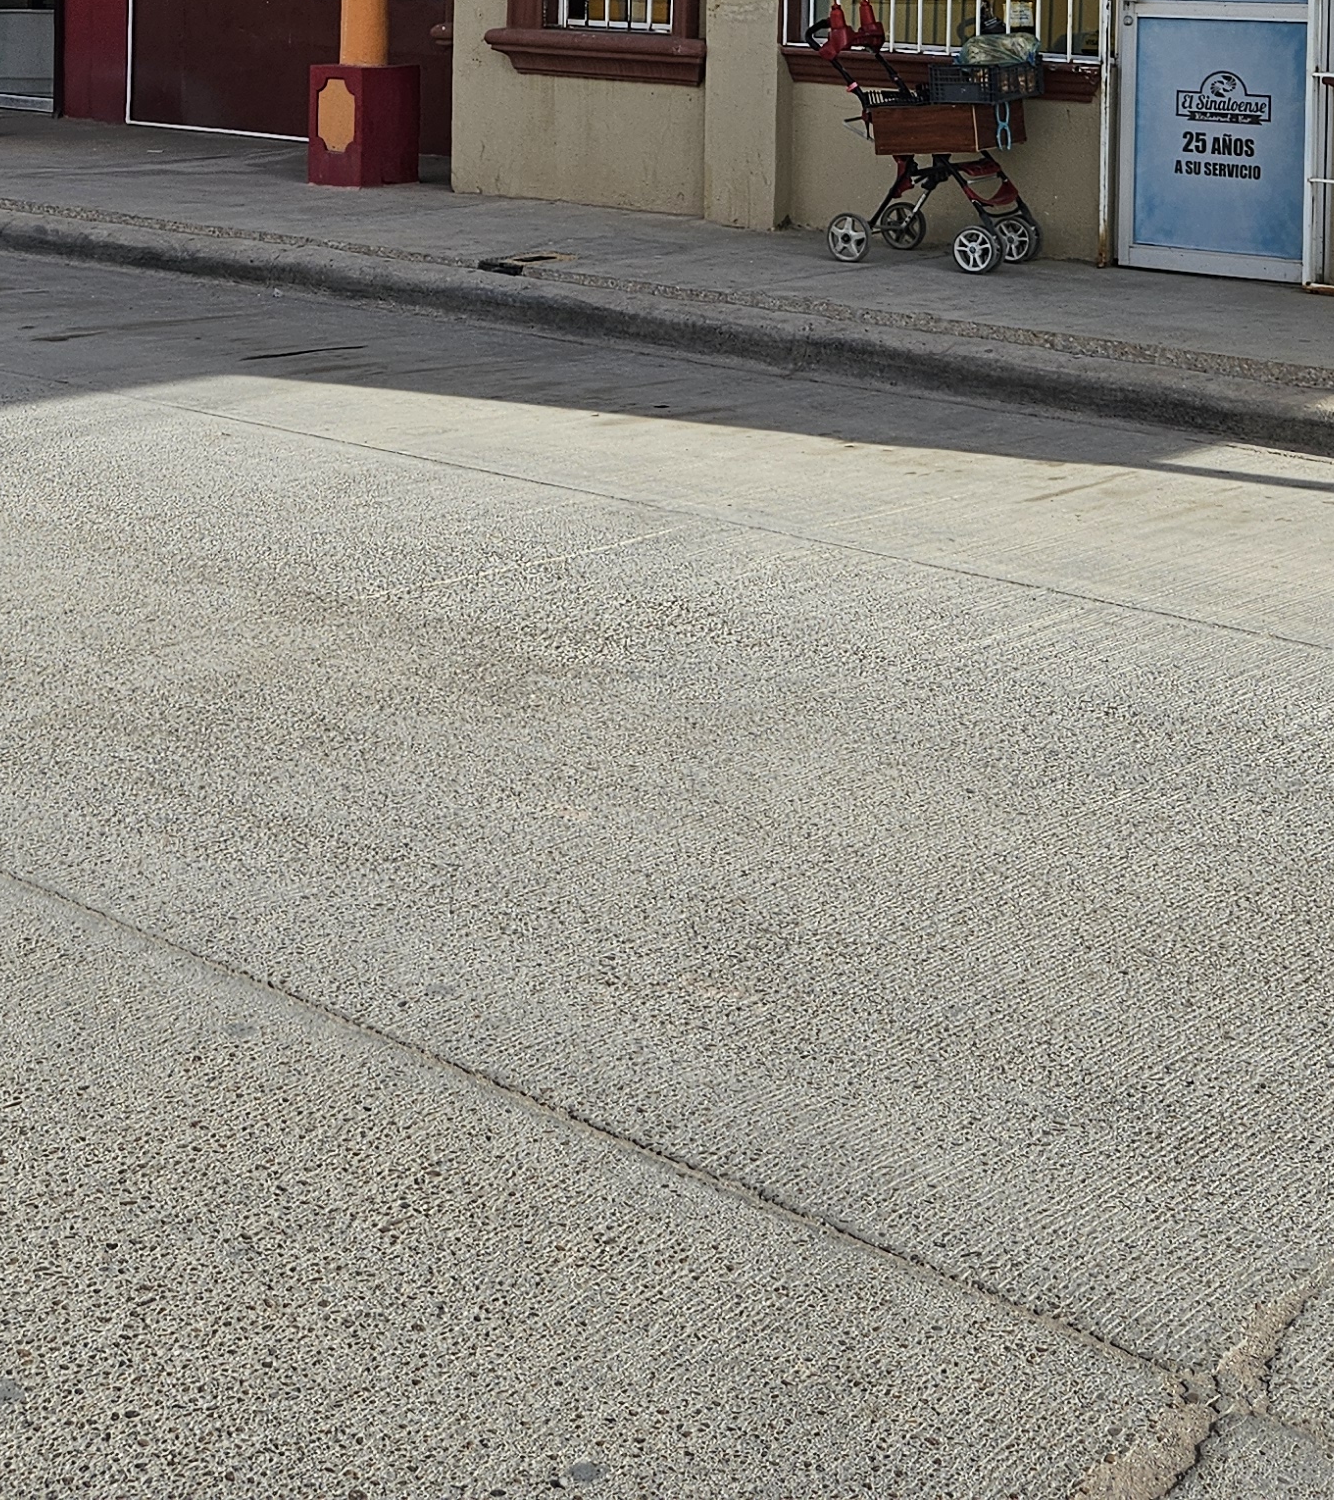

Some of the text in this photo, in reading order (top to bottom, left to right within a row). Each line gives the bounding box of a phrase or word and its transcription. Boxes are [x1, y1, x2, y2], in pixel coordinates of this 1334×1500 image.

[1181, 94, 1267, 113] El Sinaloense
[1182, 131, 1255, 157] 25 AÑOS
[1174, 160, 1261, 180] A SU SERVICIO
